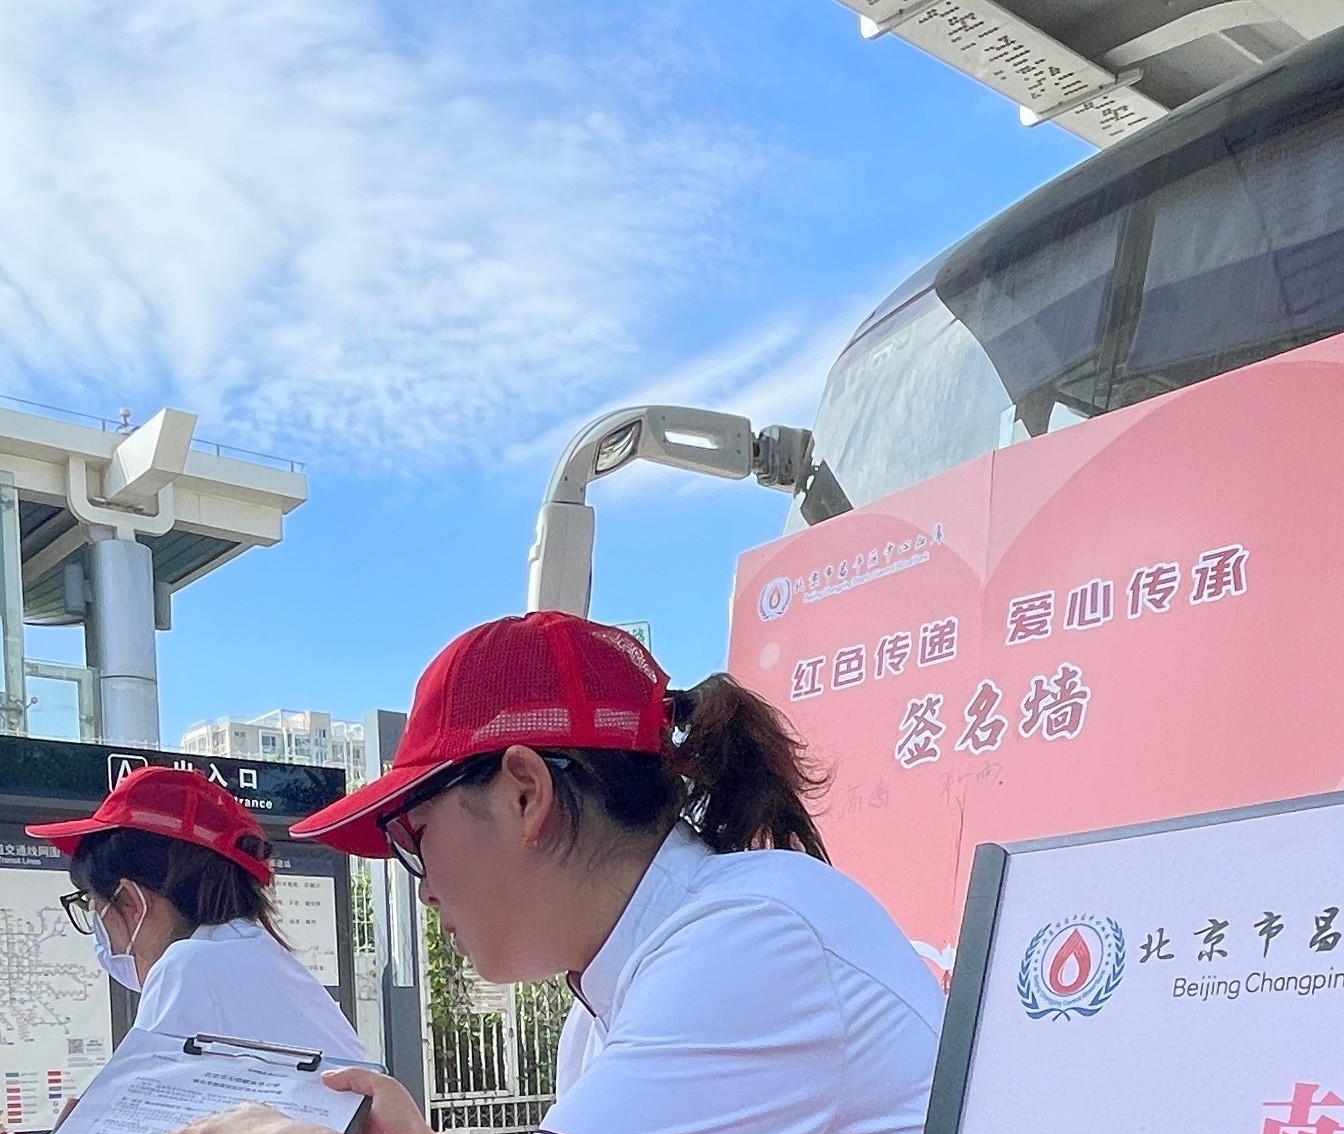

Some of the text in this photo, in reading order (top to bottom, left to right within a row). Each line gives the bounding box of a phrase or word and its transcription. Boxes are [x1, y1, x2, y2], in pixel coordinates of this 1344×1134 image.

[791, 617, 959, 700] 红色传递
[1007, 545, 1251, 645] 爱心传承
[896, 664, 1092, 769] 签名墙
[1172, 970, 1241, 1002] Beijing
